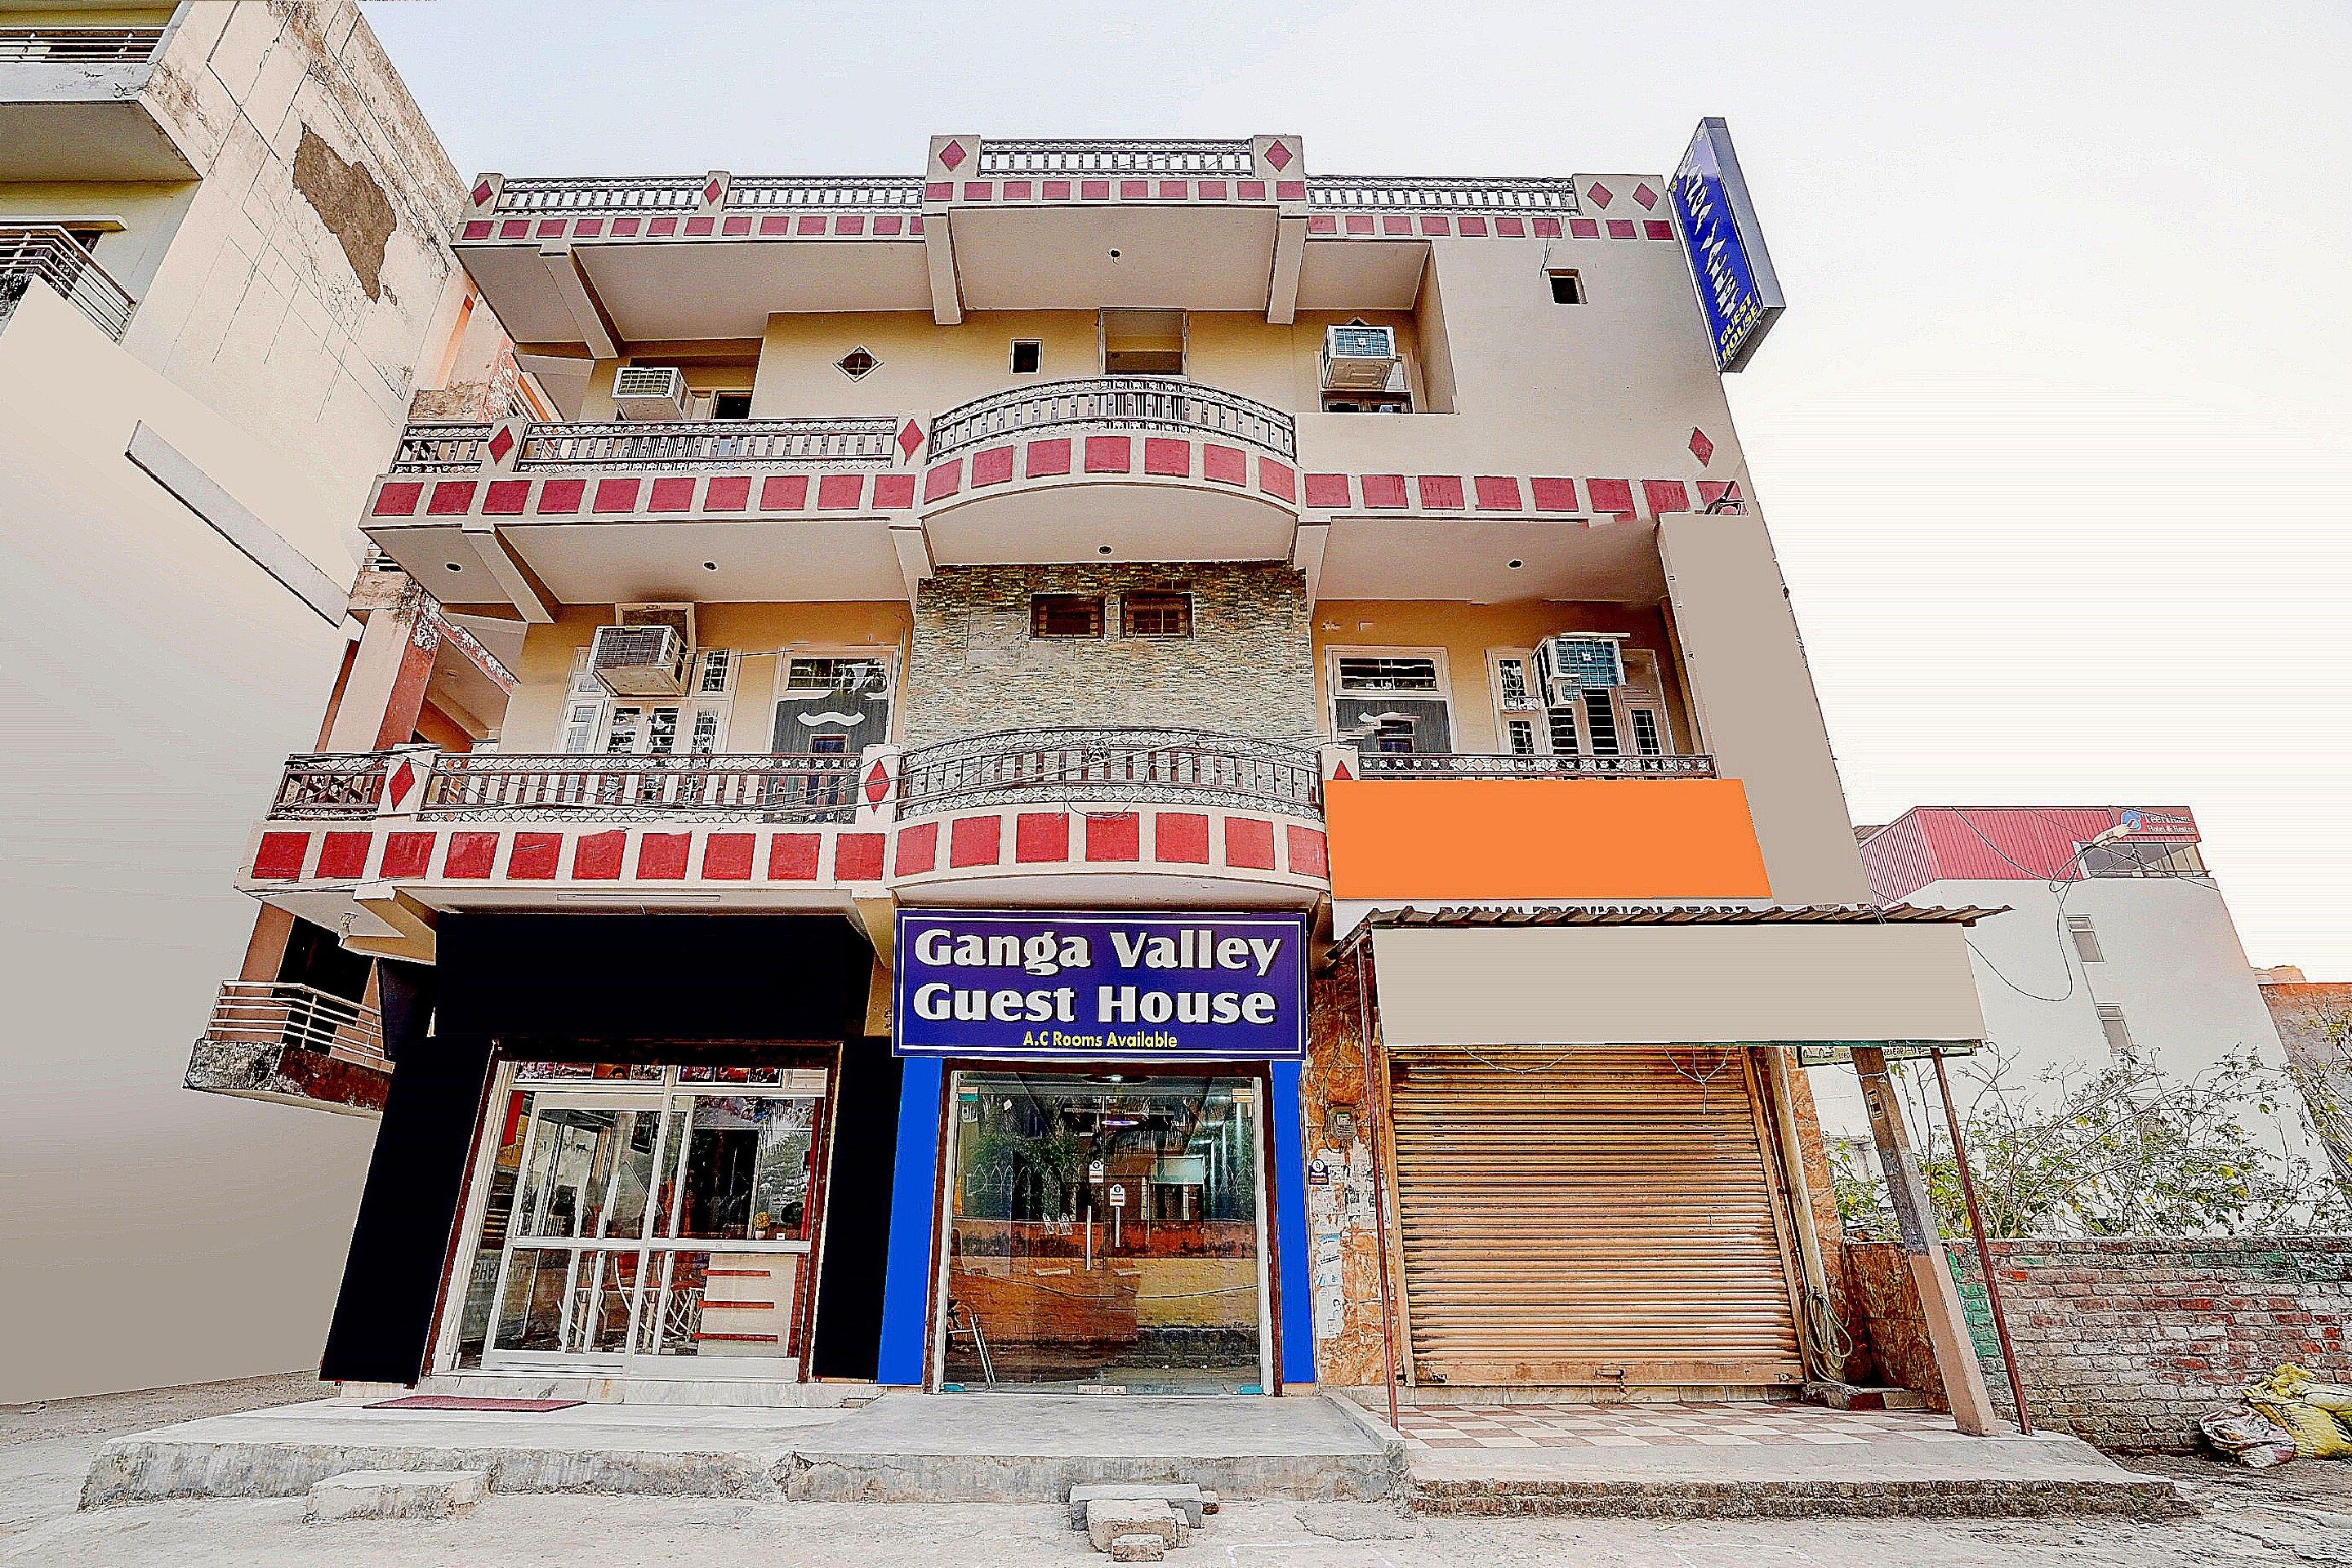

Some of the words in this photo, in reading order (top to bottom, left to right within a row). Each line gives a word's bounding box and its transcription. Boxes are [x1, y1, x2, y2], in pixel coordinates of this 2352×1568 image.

[1720, 291, 1752, 345] GUEST
[1722, 302, 1758, 363] HOUSE
[914, 929, 1091, 975] Ganga
[1109, 929, 1281, 976] Valley
[913, 982, 1075, 1022] Guest
[1098, 986, 1276, 1024] House
[1023, 1031, 1049, 1046] A.C
[1053, 1031, 1102, 1047] Rooms
[1106, 1031, 1178, 1048] Available
